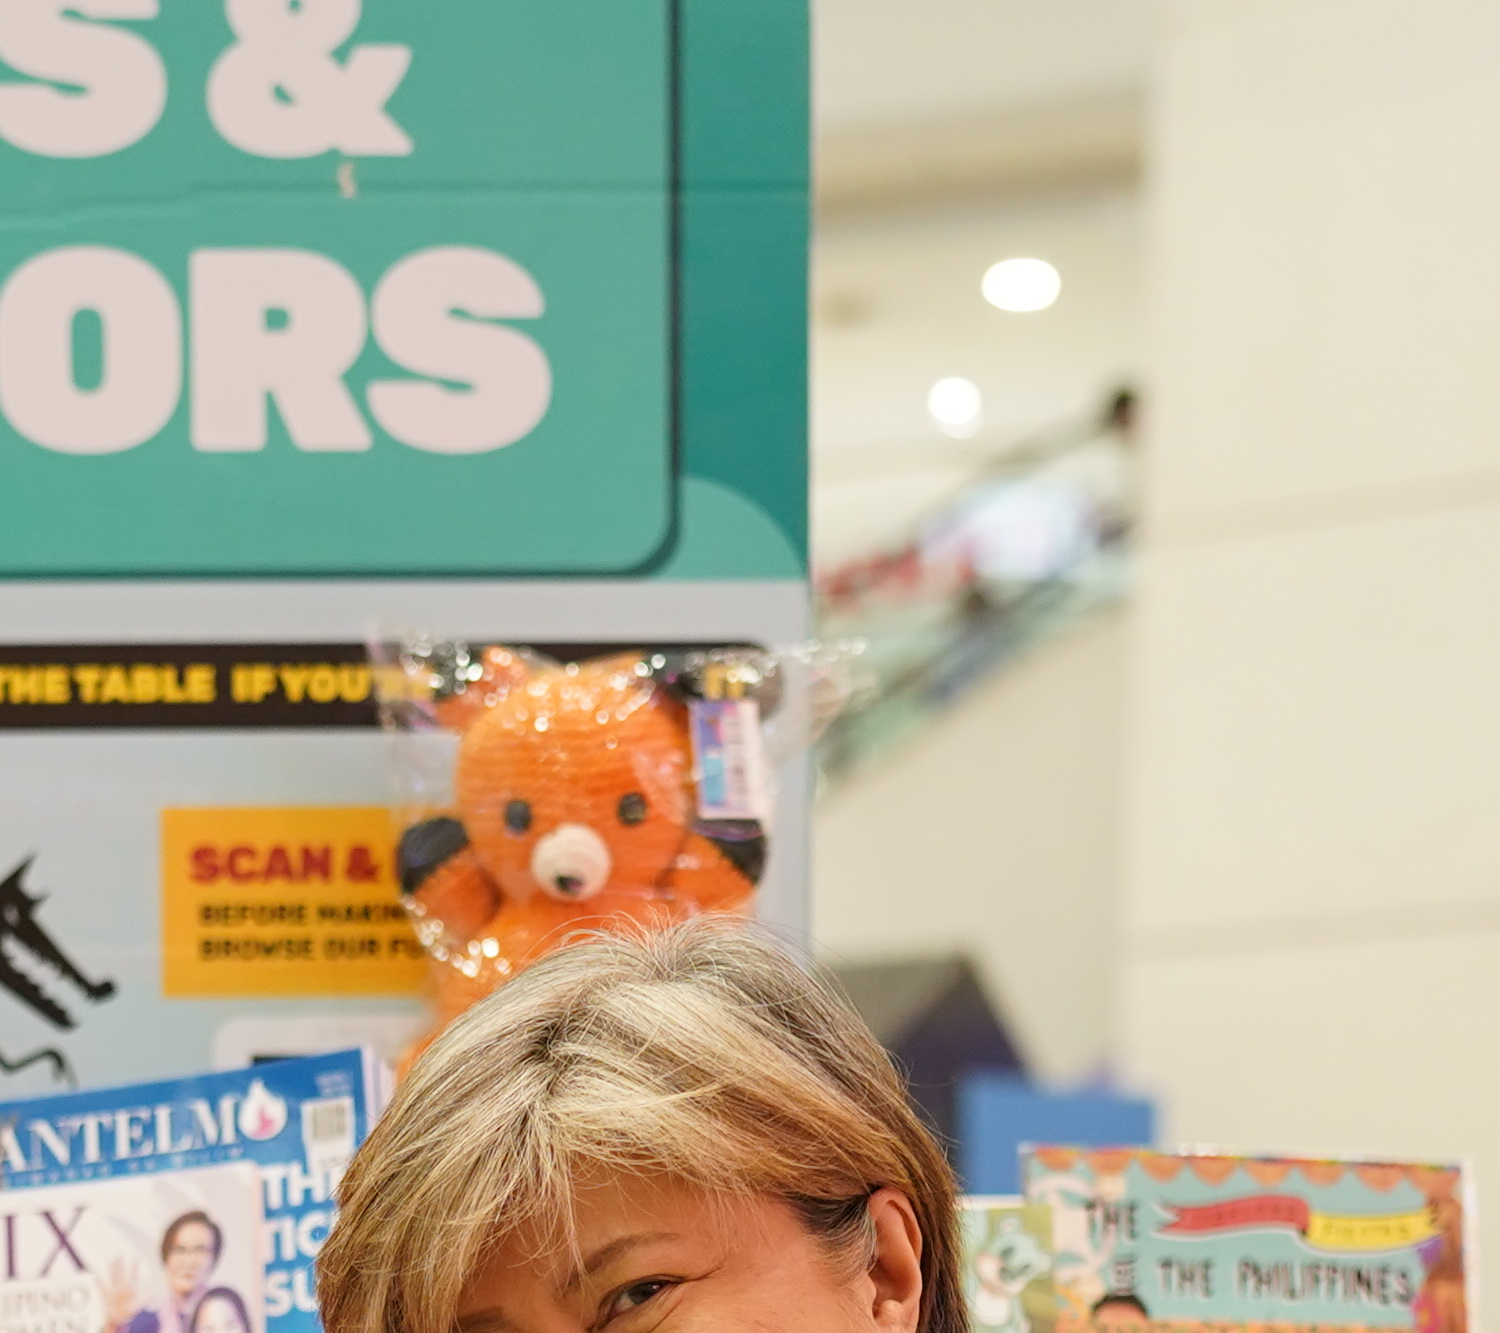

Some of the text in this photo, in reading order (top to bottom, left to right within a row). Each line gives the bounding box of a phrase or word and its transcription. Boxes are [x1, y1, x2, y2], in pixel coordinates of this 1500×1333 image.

[205, 0, 414, 158] &
[73, 663, 217, 704] TABLE
[232, 664, 277, 702] IF
[189, 845, 381, 886] SCAN &
[199, 903, 308, 927] BEFORE
[199, 937, 315, 962] BROWSE
[322, 937, 381, 961] OUR
[1156, 1258, 1214, 1299] THE
[1236, 1258, 1415, 1308] PHILIPPINES
